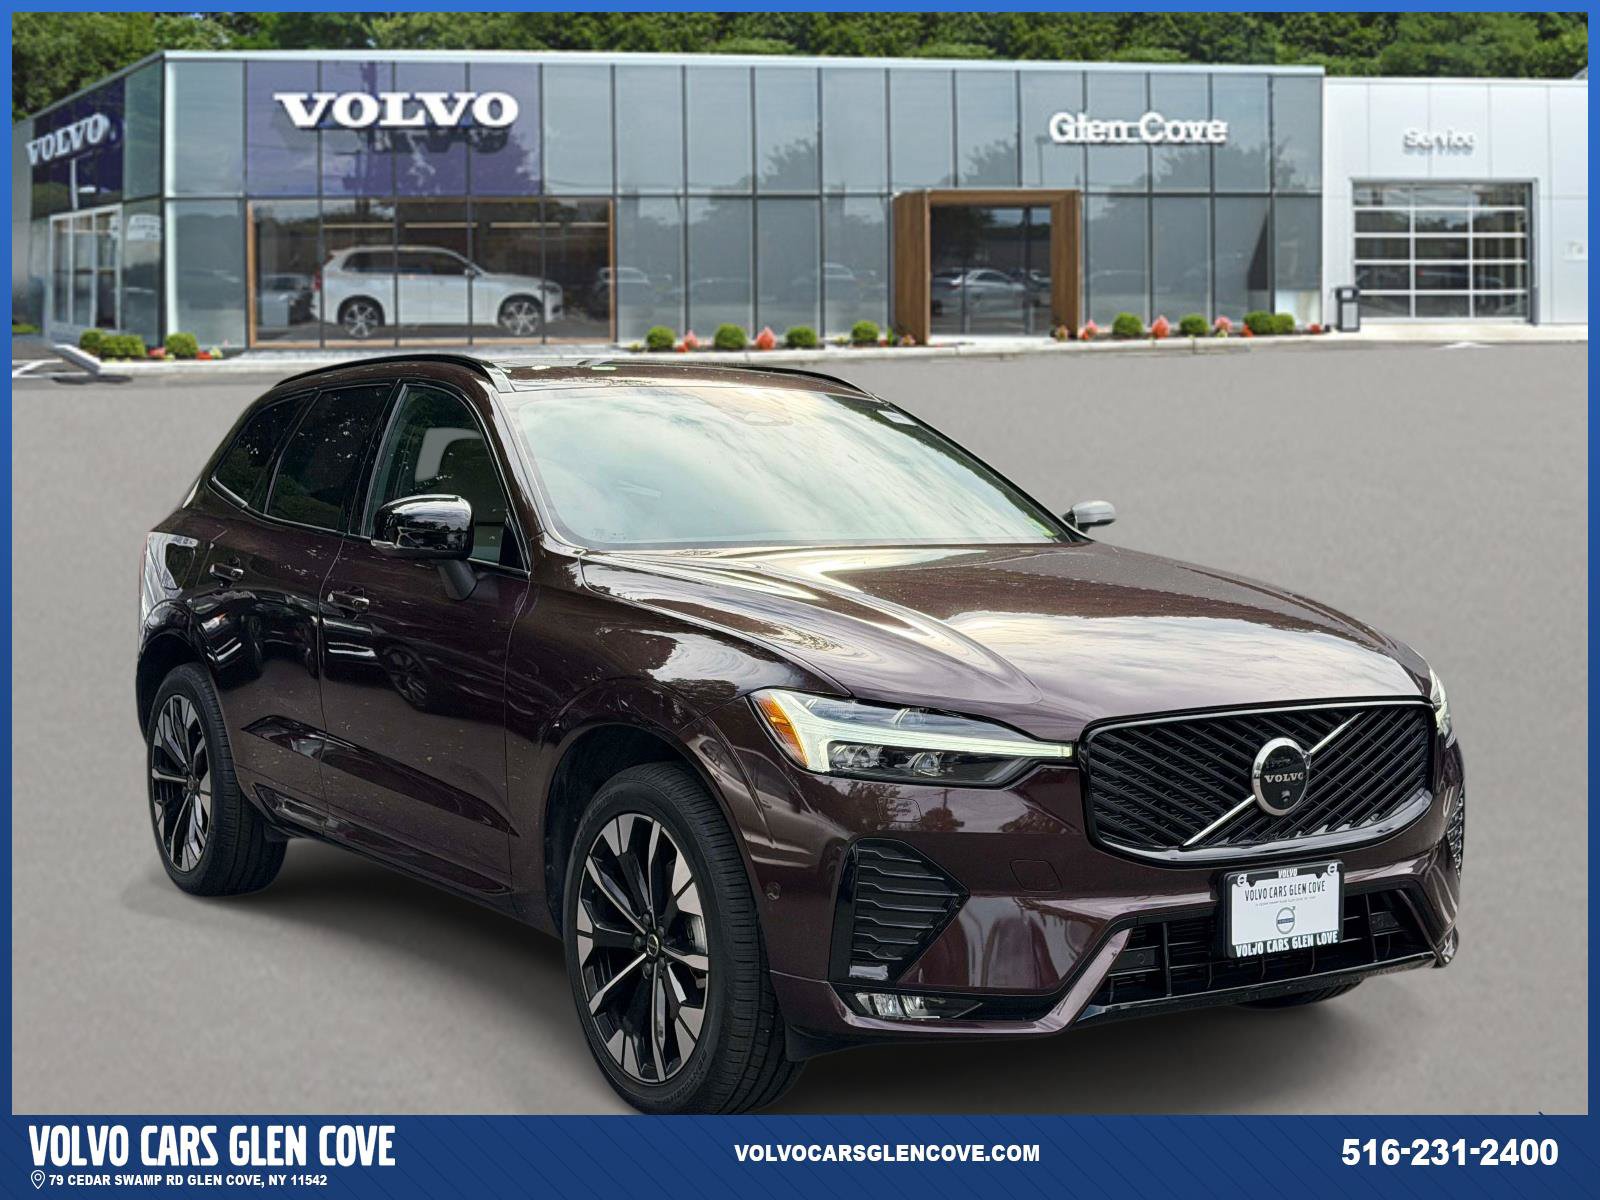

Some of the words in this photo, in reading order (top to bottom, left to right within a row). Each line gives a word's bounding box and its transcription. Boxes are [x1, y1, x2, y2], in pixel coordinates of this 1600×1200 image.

[274, 91, 519, 128] VOLVO
[1049, 111, 1130, 143] Glen
[1138, 111, 1228, 143] Cove
[26, 113, 110, 165] VOLVO
[1402, 128, 1475, 153] Service
[1264, 772, 1304, 783] VOLVO
[1278, 868, 1298, 878] VOLVO
[1245, 887, 1268, 902] VOLVO
[1269, 885, 1287, 899] CARS
[1289, 882, 1307, 896] GLEN
[1308, 880, 1326, 894] COVE
[1266, 938, 1290, 953] CARS
[1291, 933, 1314, 949] GLEN
